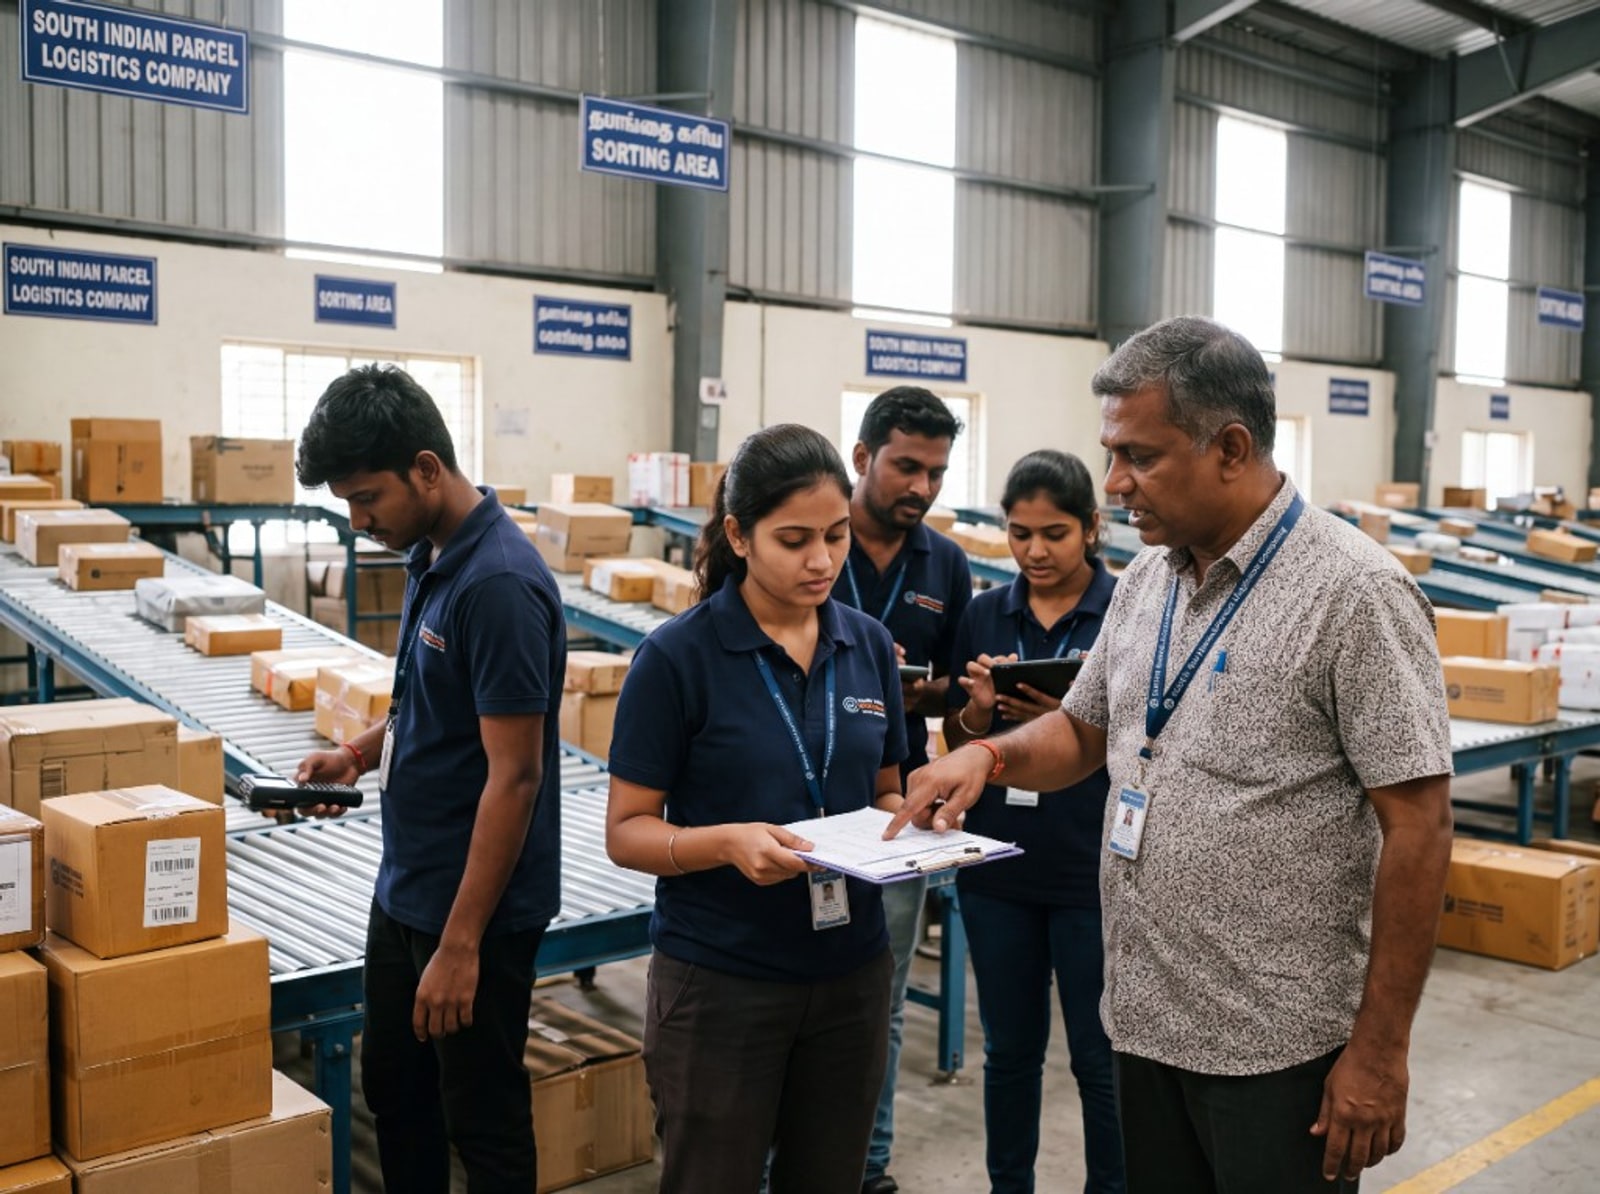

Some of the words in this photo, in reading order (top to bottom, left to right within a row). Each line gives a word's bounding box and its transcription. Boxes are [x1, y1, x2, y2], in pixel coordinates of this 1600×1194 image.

[33, 9, 98, 42] SOUTH
[104, 21, 168, 54] INDIAN
[172, 37, 239, 67] PARCEL
[42, 43, 141, 81] LOGISTICS
[145, 61, 232, 96] COMPANY
[591, 137, 671, 172] SORTING
[674, 152, 720, 180] AREA
[10, 256, 54, 277] SOUTH
[58, 260, 101, 281] INDIAN
[104, 264, 151, 285] PARCEL
[12, 284, 83, 307] LOGISTICS
[86, 290, 149, 312] COMPANY
[319, 290, 364, 311] SORTING
[365, 294, 392, 313] AREA
